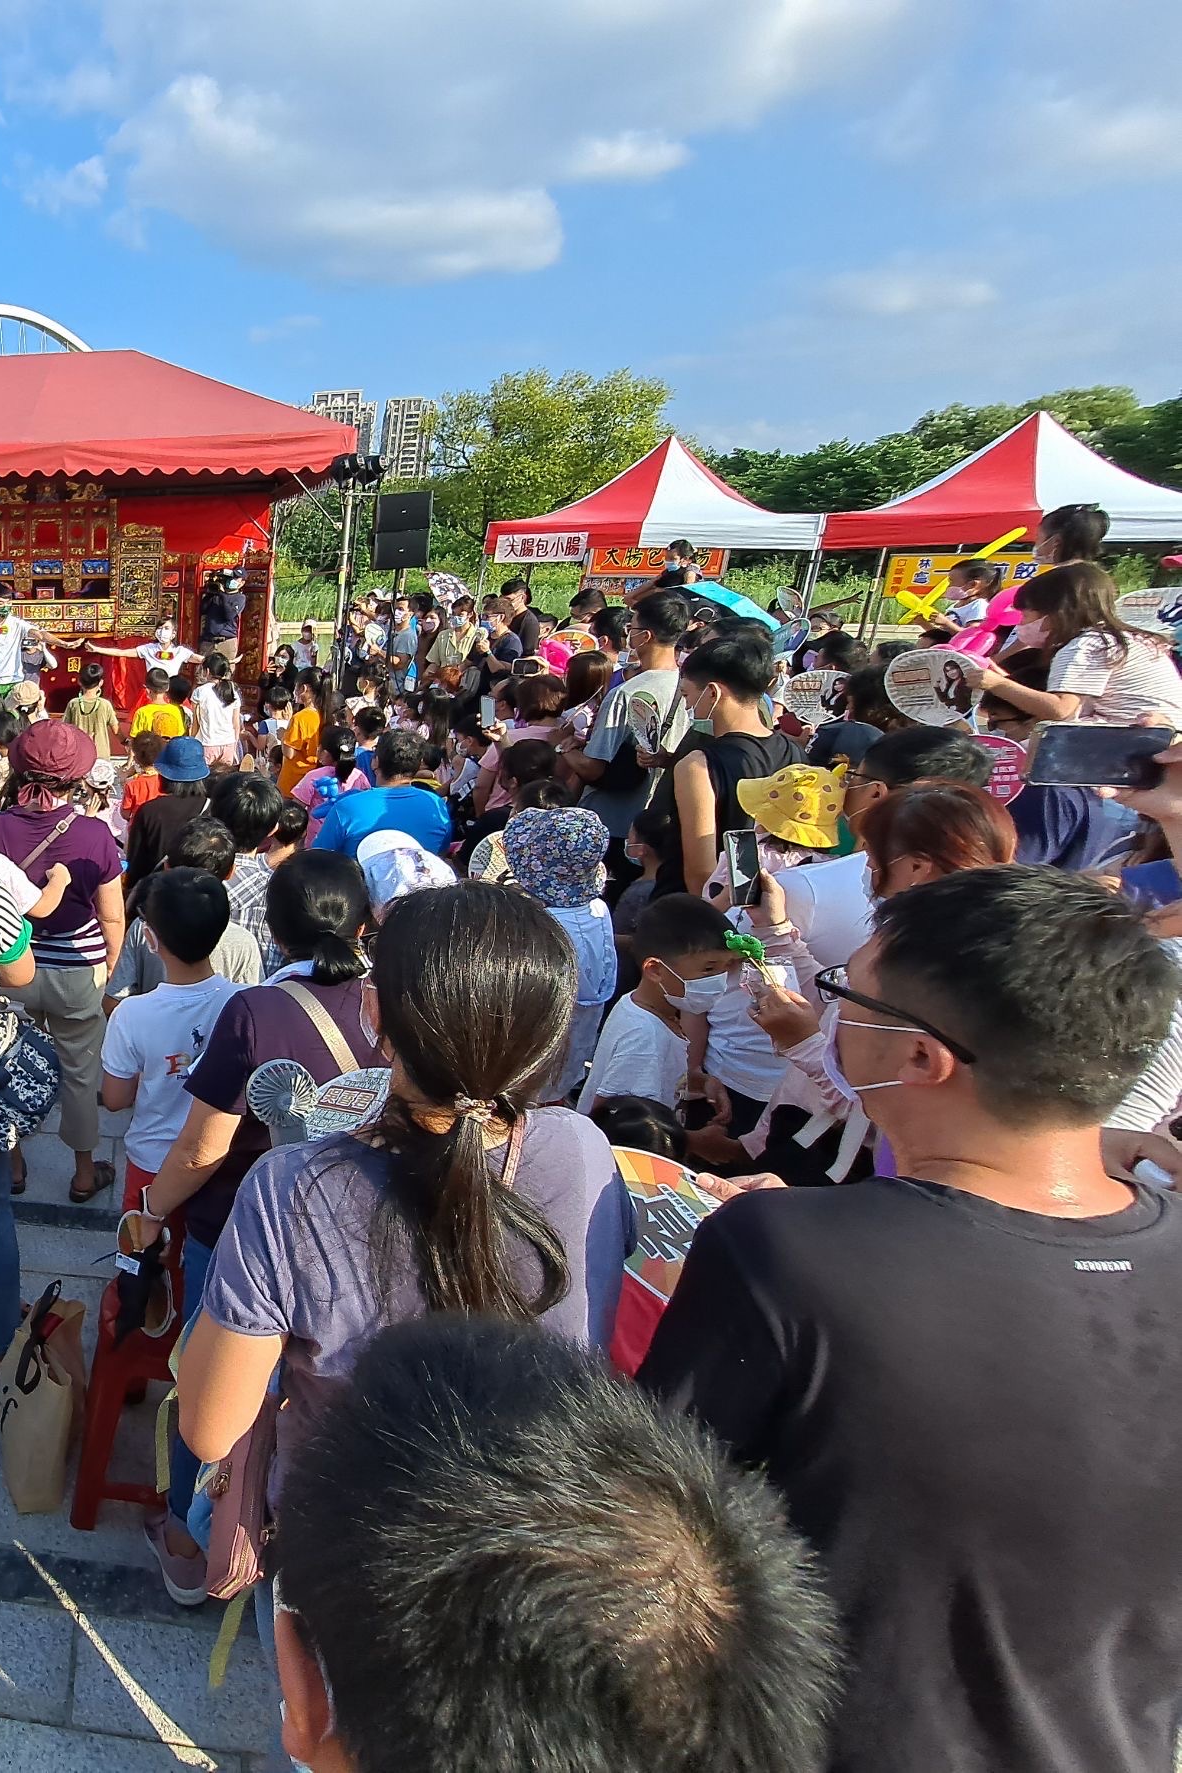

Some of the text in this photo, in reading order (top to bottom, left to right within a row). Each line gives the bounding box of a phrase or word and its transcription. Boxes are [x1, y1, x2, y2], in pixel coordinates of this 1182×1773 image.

[504, 535, 581, 558] 大腸包小腸
[319, 1087, 376, 1110] 吳香君
